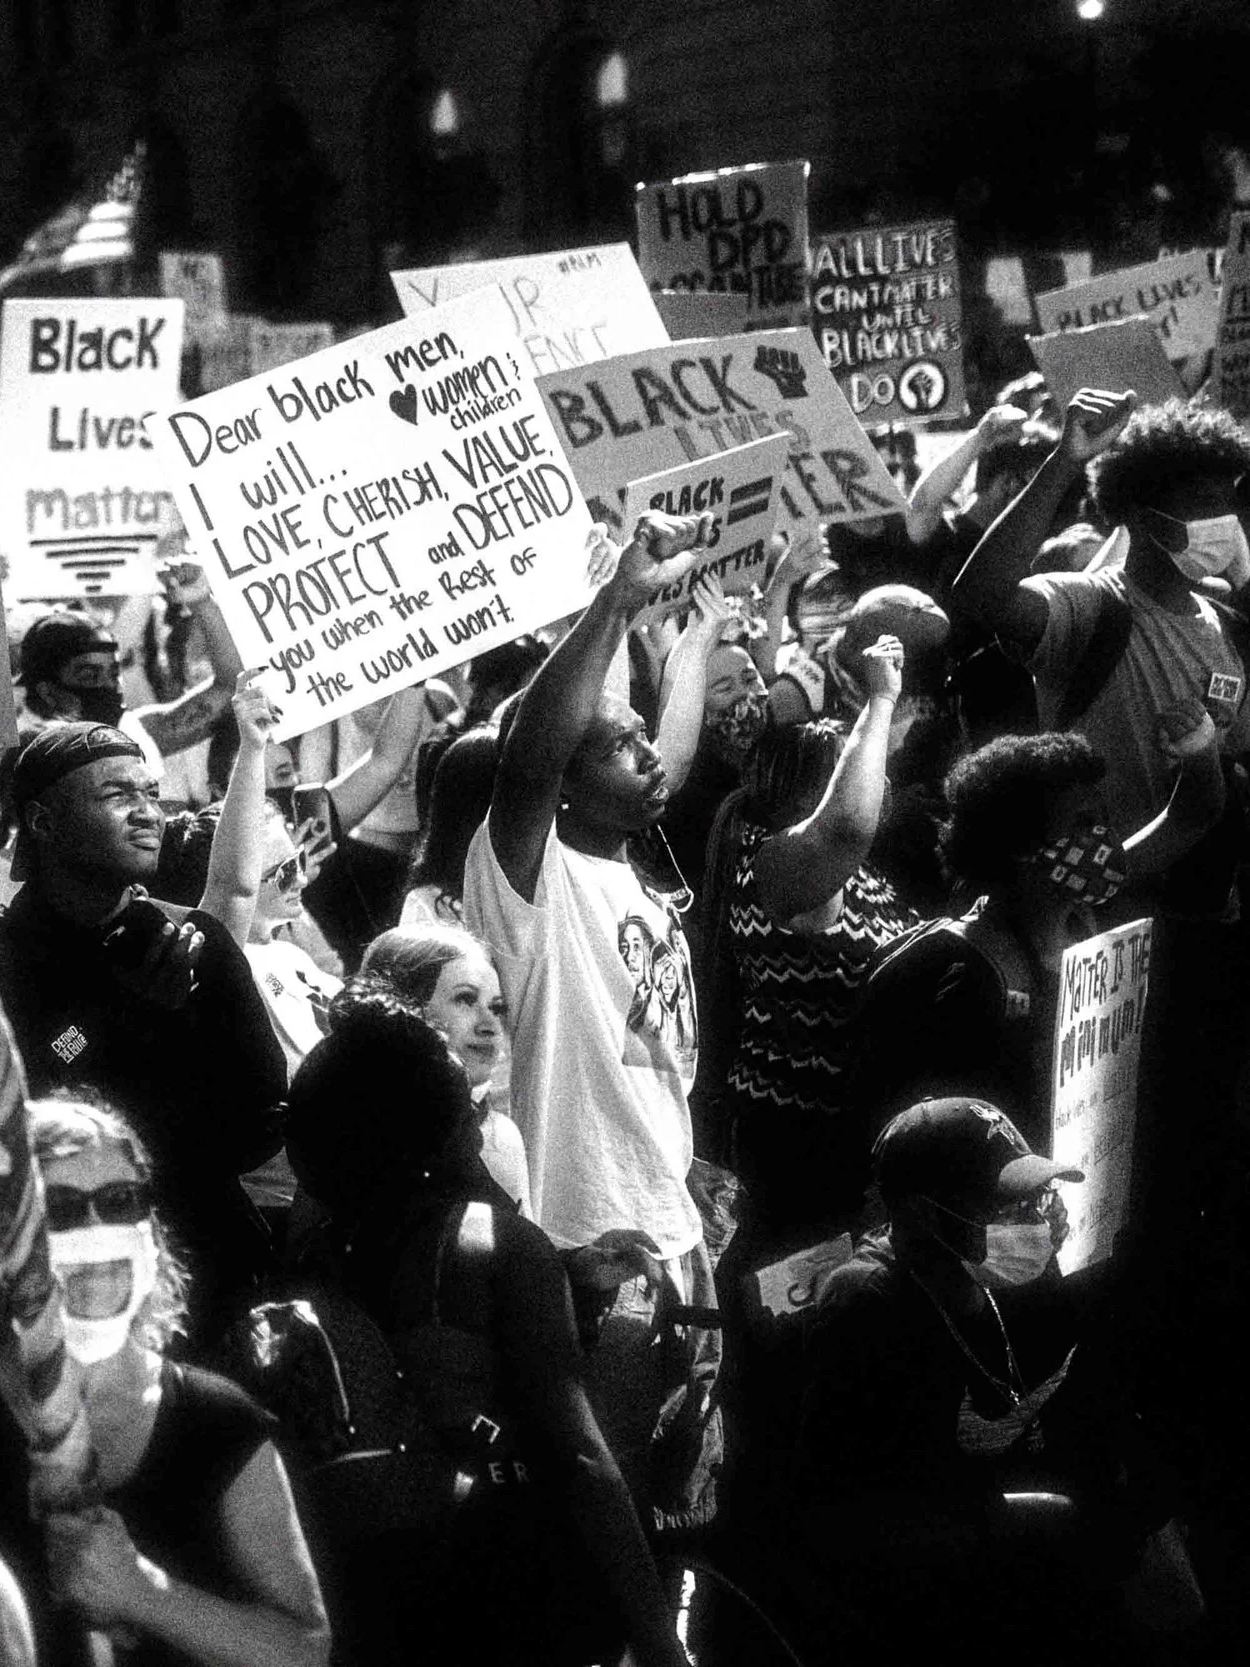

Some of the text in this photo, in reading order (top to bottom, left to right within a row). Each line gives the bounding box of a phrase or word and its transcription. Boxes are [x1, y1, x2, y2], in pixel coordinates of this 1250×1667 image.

[656, 178, 764, 242] HOLD
[29, 317, 166, 374] Black
[168, 331, 465, 468] Dear black men,
[422, 355, 508, 416] women
[450, 387, 521, 431] children
[550, 354, 757, 449] BLACK
[189, 483, 215, 531] I
[212, 504, 323, 580] LOVE,
[322, 462, 450, 538] CHERISH,
[242, 463, 574, 644] PROTECT and DEFEND
[325, 607, 384, 652] when
[390, 589, 434, 622] the
[306, 669, 354, 707] the
[360, 628, 440, 685] world
